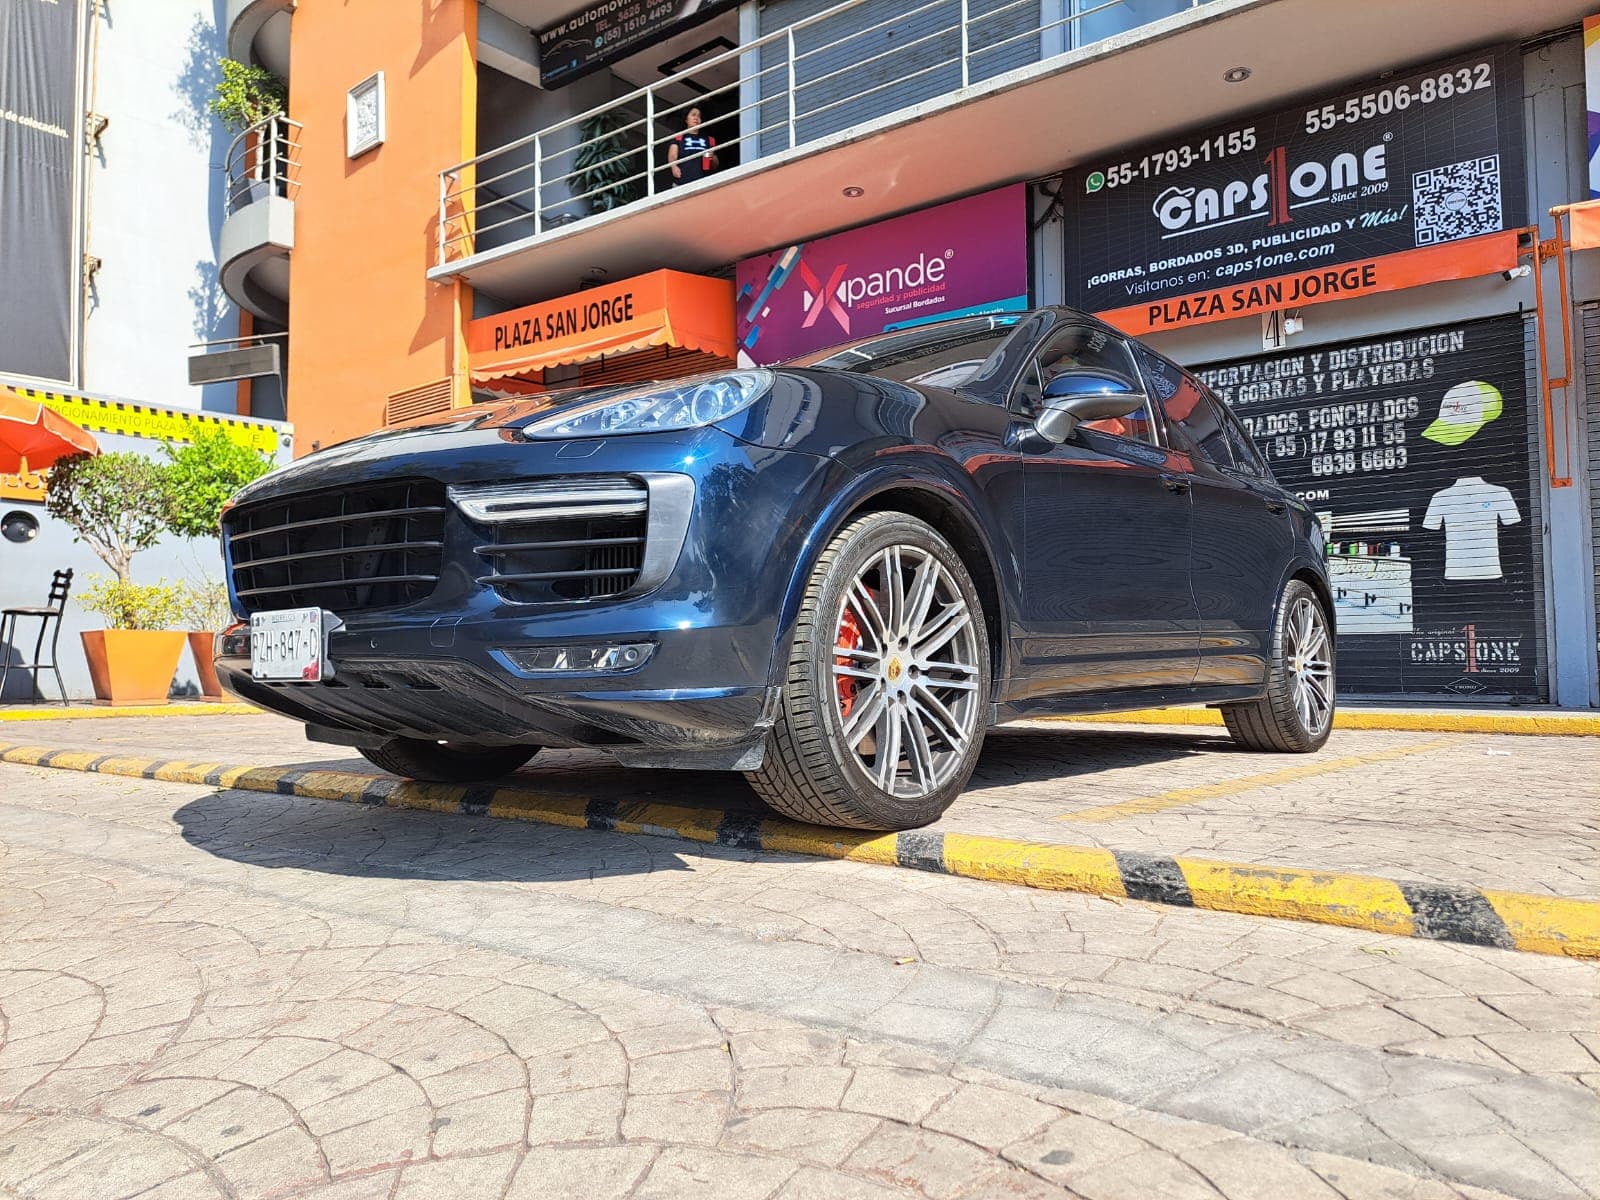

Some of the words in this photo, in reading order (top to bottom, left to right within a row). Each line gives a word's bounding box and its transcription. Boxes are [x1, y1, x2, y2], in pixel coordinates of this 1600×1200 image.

[1305, 63, 1492, 134] 55-5506-8832
[5, 110, 18, 122] de
[18, 115, 69, 138] colocación.
[1106, 127, 1257, 188] 55-1793-1155
[1330, 191, 1358, 204] Since
[1361, 181, 1389, 197] 2009
[1149, 248, 1222, 273] BORDADOS
[1226, 242, 1248, 256] 3D,
[1252, 221, 1342, 250] PUBLICIDAD
[1345, 218, 1356, 230] Y
[1359, 204, 1409, 229] Más!
[1125, 276, 1184, 296] Visítanos
[1187, 269, 1210, 282] en:
[1215, 243, 1335, 277] caps1one.com
[856, 294, 895, 310] seguridad
[896, 293, 902, 302] y
[903, 282, 946, 300] publicidad
[885, 302, 912, 314] Sucursal
[913, 295, 946, 309] Bordados
[1149, 293, 1226, 326] PLAZA
[1231, 282, 1282, 311] SAN
[1289, 264, 1377, 301] JORGE
[495, 318, 542, 351] PLAZA
[546, 309, 577, 340] SAN
[581, 293, 633, 331] JORGE
[1265, 310, 1281, 346] 4
[1310, 353, 1323, 373] Y
[1329, 331, 1465, 369] DISTRIBUCION
[1238, 376, 1307, 405] GORRAS
[1313, 373, 1326, 393] Y
[1331, 358, 1435, 392] PLAYERAS
[144, 418, 176, 432] PLAZA
[1333, 427, 1356, 451] 93
[1361, 424, 1377, 448] 11
[1382, 421, 1406, 445] 55
[1311, 451, 1356, 476] 6838
[1361, 445, 1408, 472] 6683
